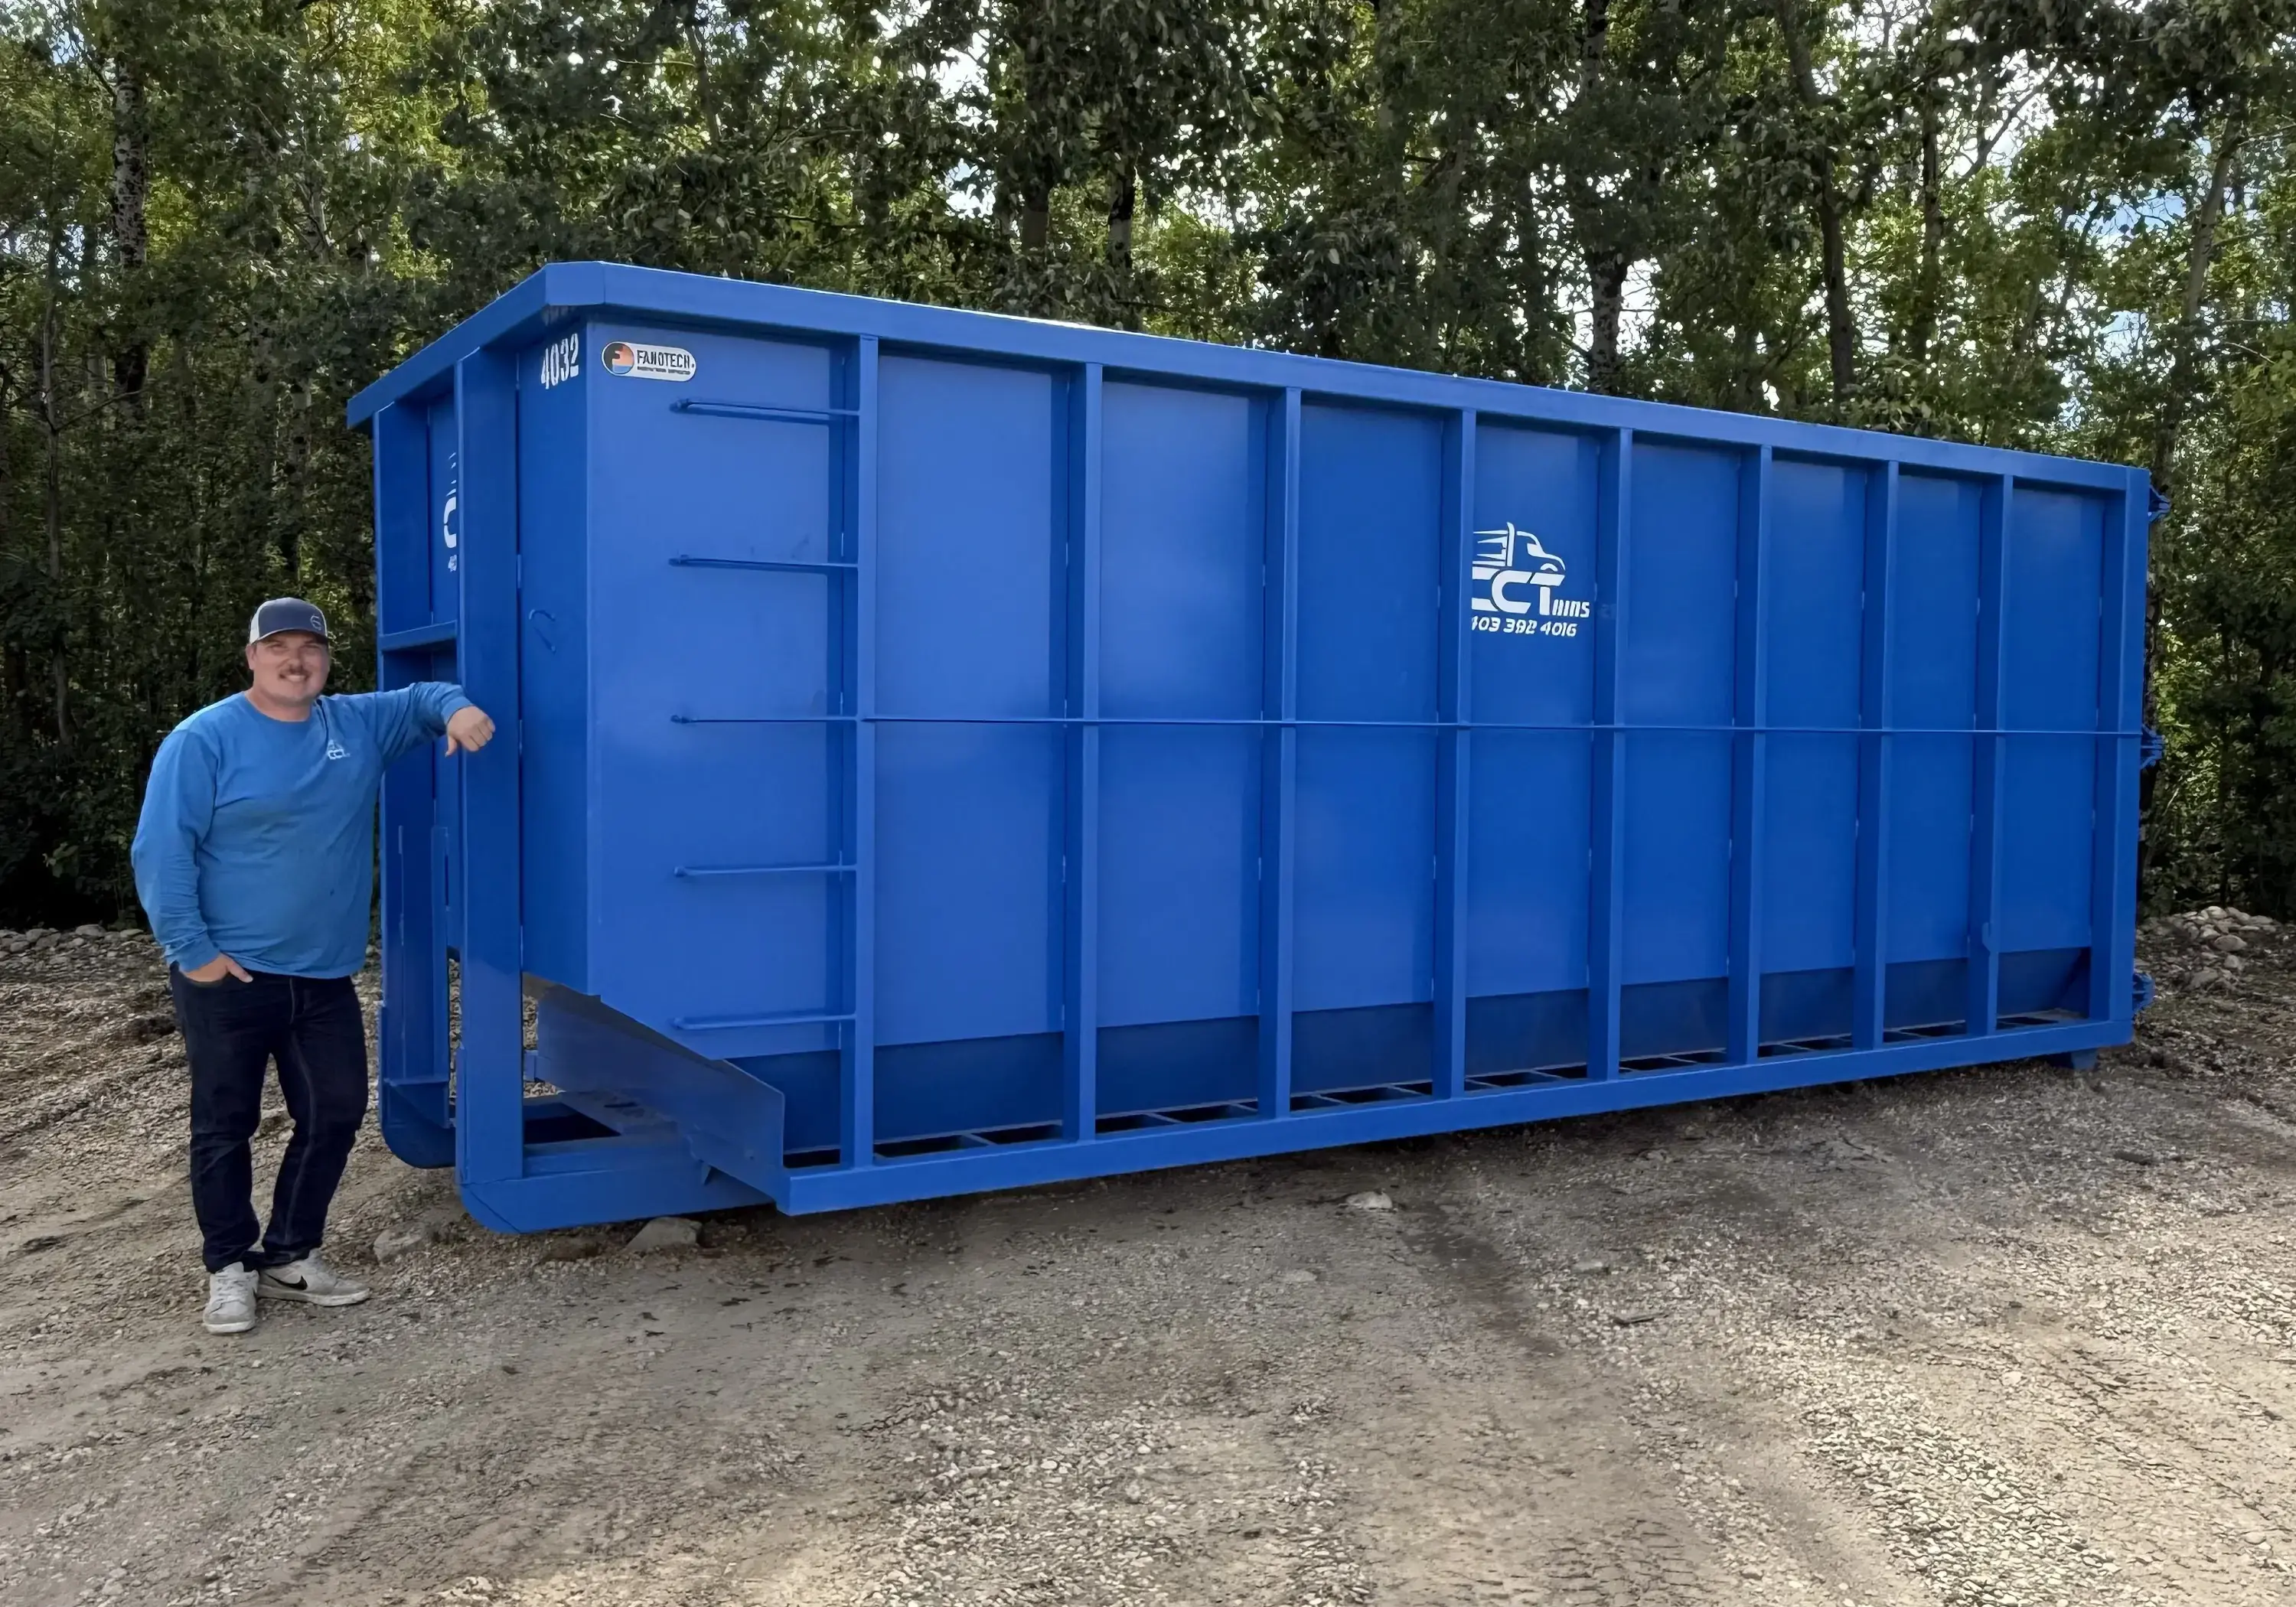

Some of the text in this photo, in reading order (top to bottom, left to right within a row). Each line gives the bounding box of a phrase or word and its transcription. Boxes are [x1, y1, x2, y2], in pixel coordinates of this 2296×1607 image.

[541, 333, 579, 390] 4032
[637, 350, 690, 369] FANOTECH
[1540, 621, 1578, 637] 4016
